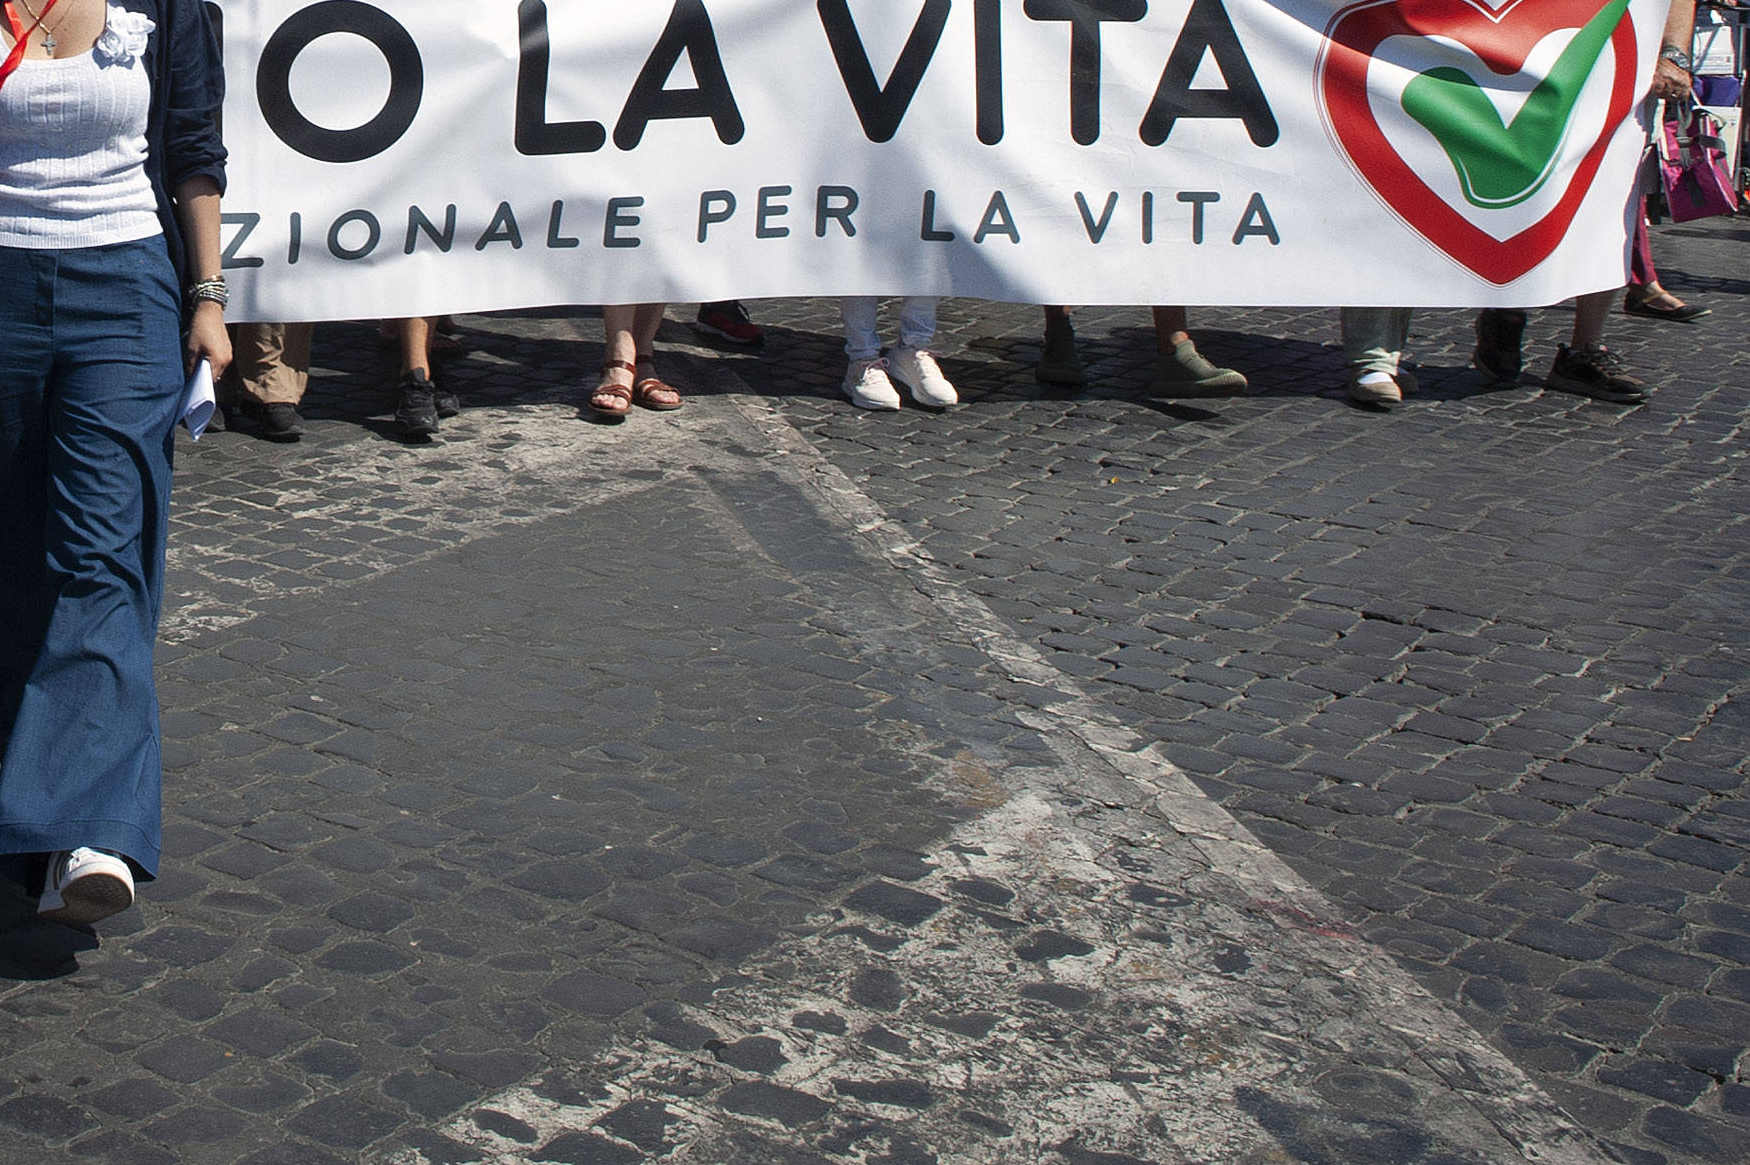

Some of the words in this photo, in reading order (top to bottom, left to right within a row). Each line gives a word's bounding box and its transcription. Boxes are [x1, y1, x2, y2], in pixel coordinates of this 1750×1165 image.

[697, 184, 860, 244] PER
[921, 189, 1021, 245] LA
[1074, 190, 1281, 246] VITA
